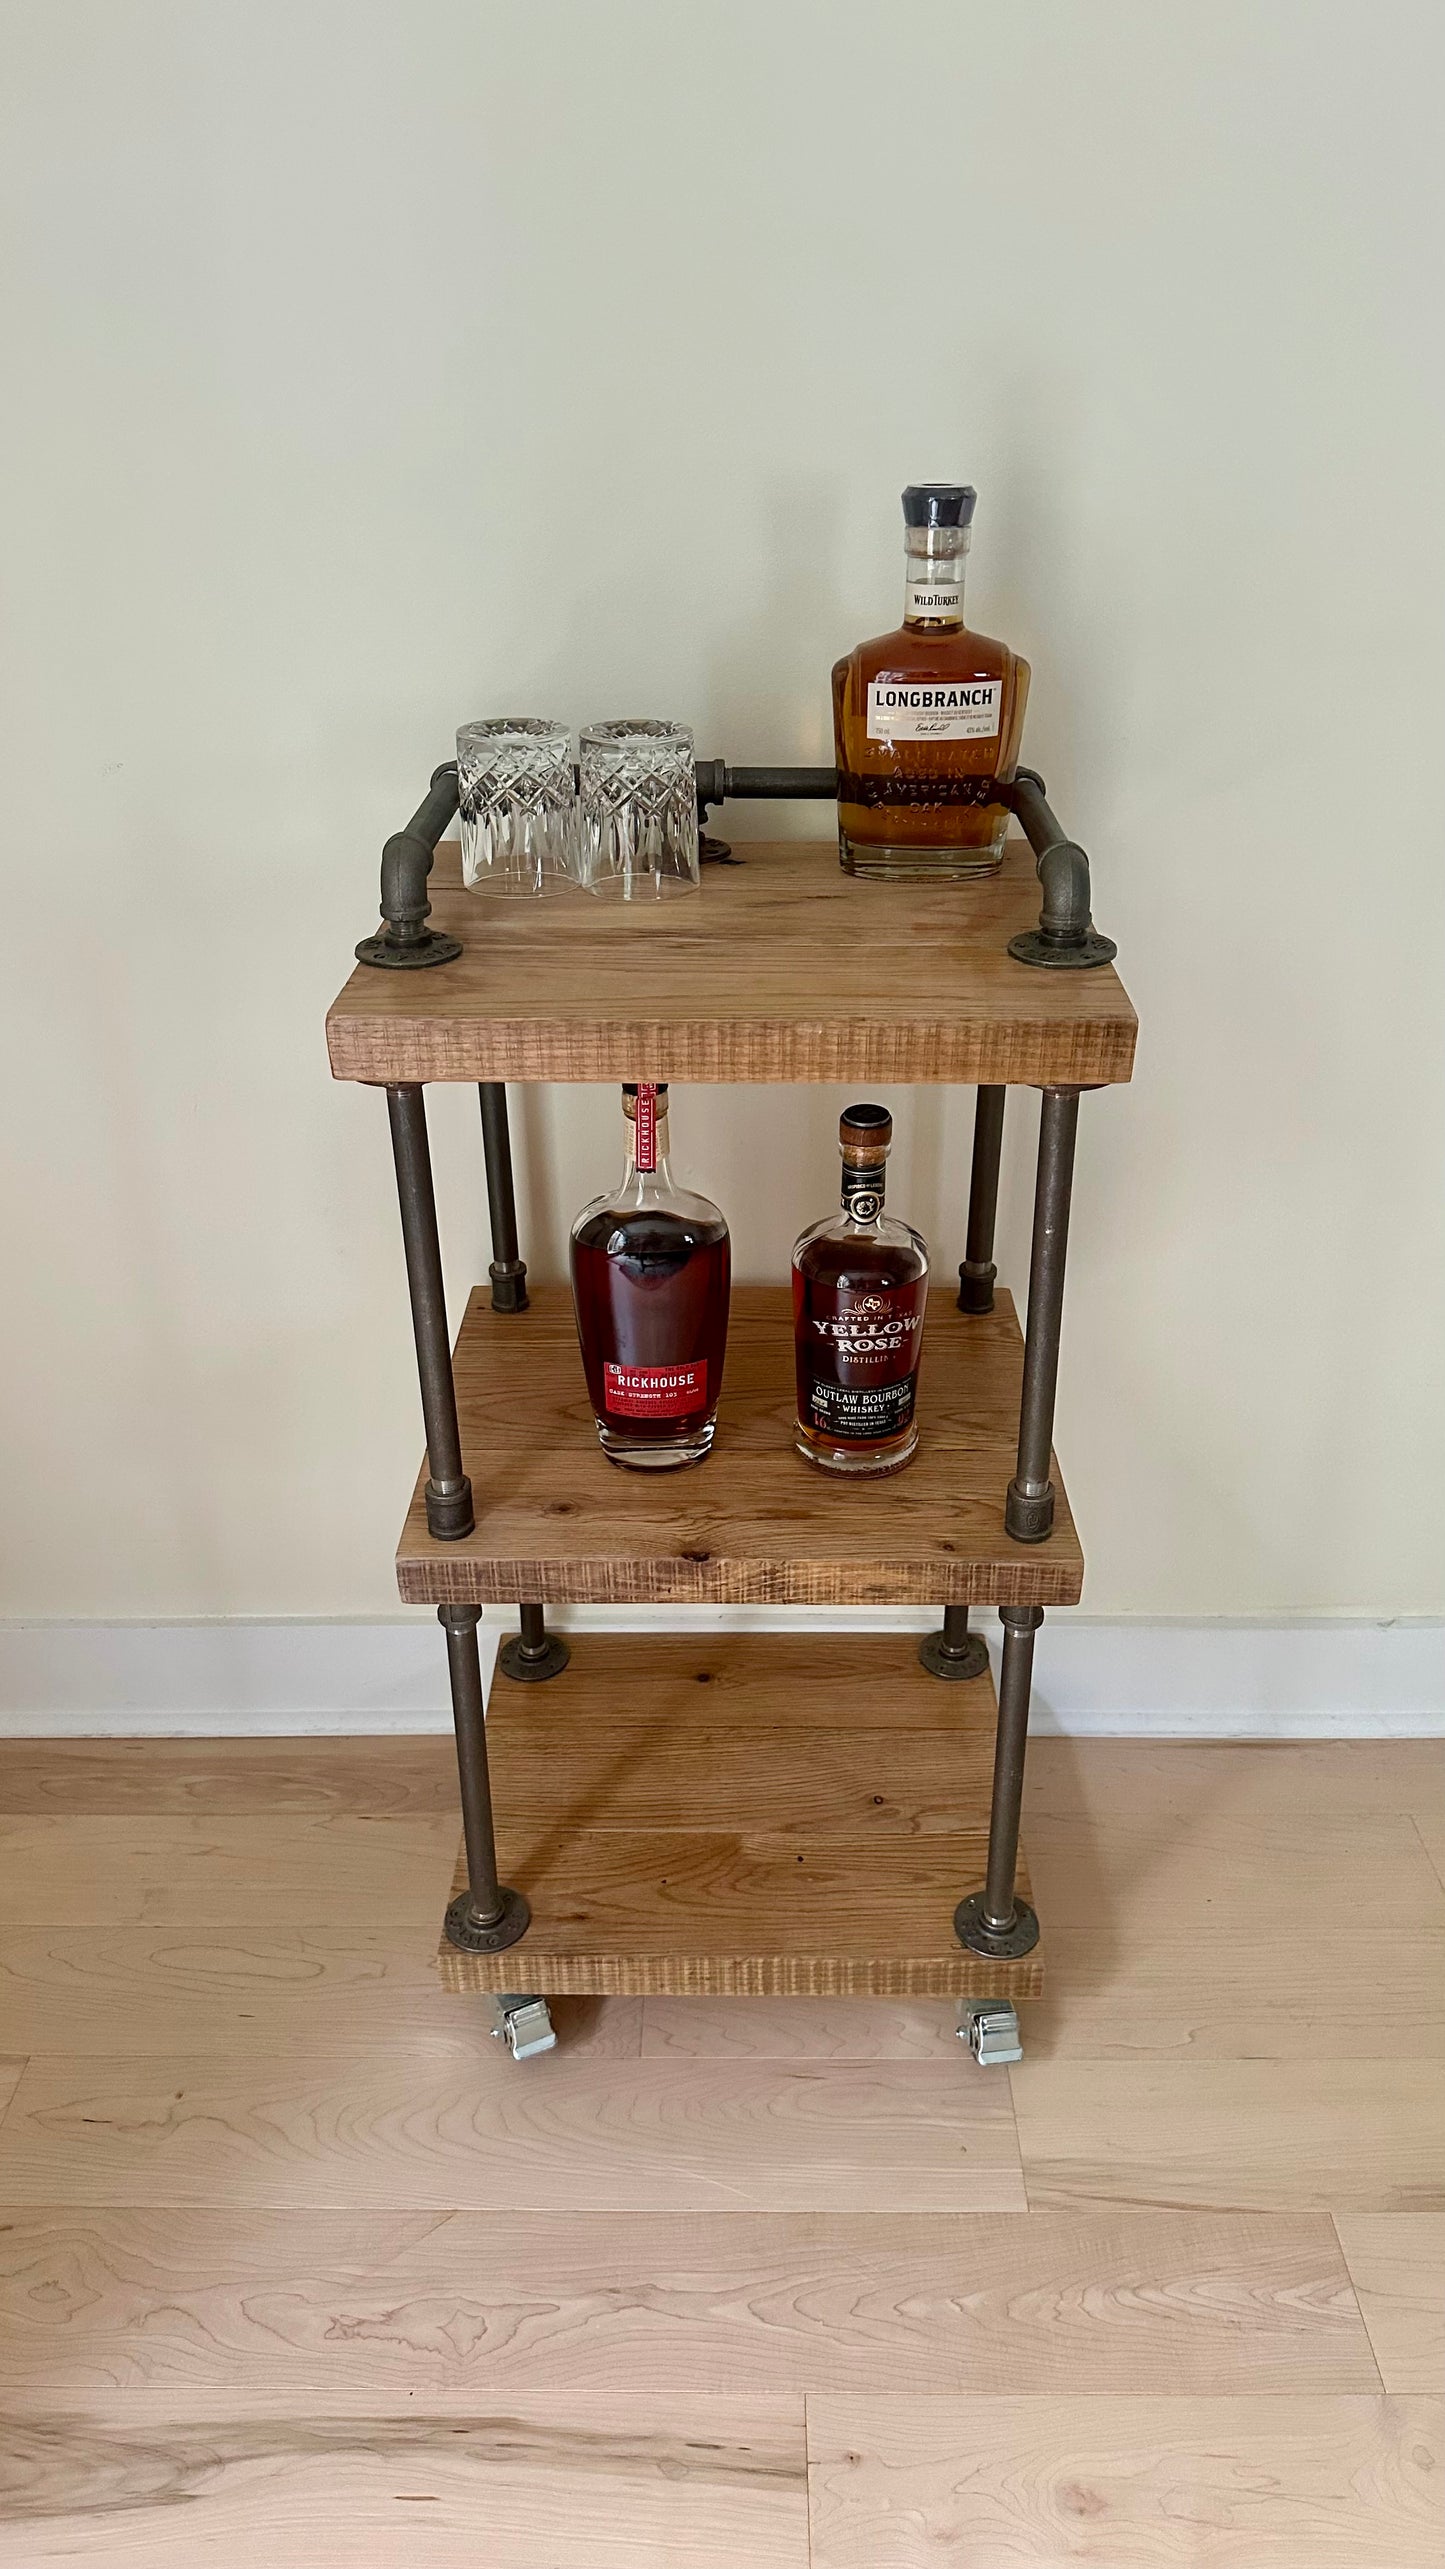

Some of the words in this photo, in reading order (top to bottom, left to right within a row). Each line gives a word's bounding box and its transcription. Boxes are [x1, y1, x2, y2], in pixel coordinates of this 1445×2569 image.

[876, 688, 993, 707] LONGBRANCH
[641, 1099, 650, 1164] RICKHOUSE
[888, 1311, 913, 1320] TXAS
[812, 1315, 921, 1337] YELLOW
[836, 1337, 902, 1353] ROSE
[842, 1355, 896, 1364] DISTILLIN
[618, 1373, 695, 1389] RICKHOUSE
[816, 1386, 858, 1405] OUTLAW
[862, 1384, 909, 1405] BOURBON
[842, 1404, 885, 1414] WHISKEY
